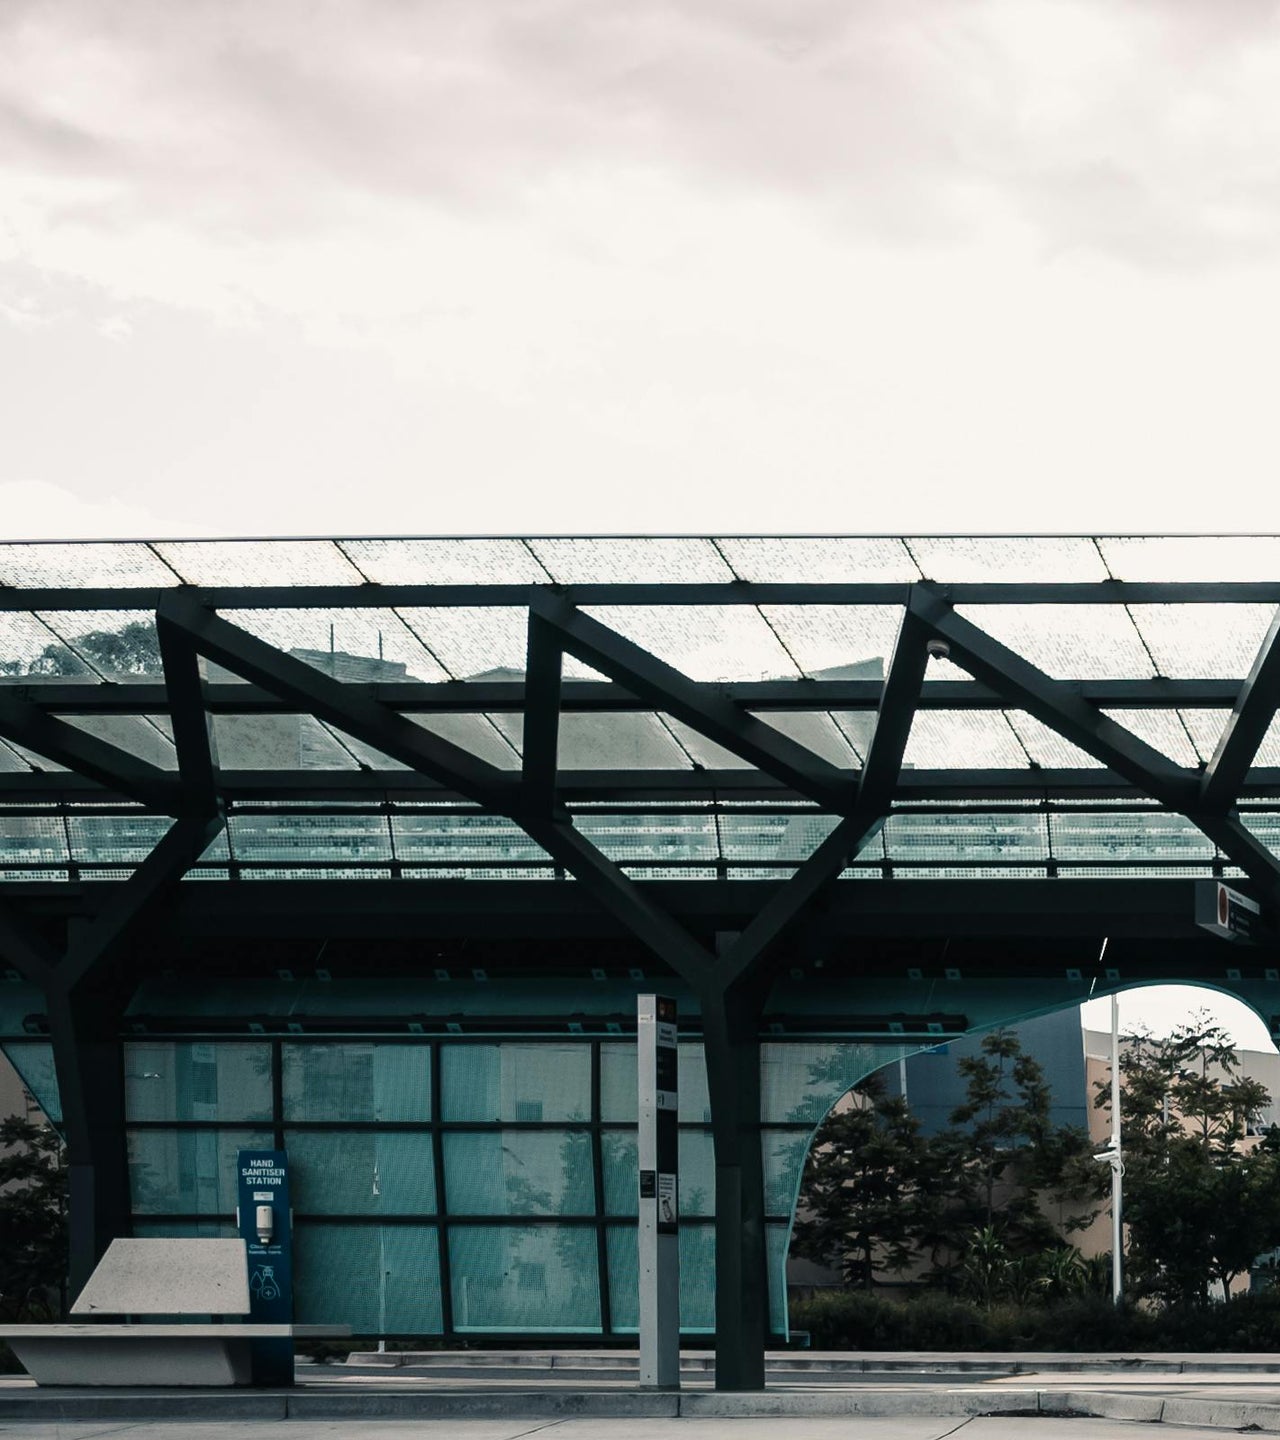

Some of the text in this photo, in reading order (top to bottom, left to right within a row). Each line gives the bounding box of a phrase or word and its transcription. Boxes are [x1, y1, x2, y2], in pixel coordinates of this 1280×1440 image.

[250, 1159, 274, 1167] HAND
[242, 1168, 285, 1176] SANITISER
[246, 1176, 282, 1185] STATION
